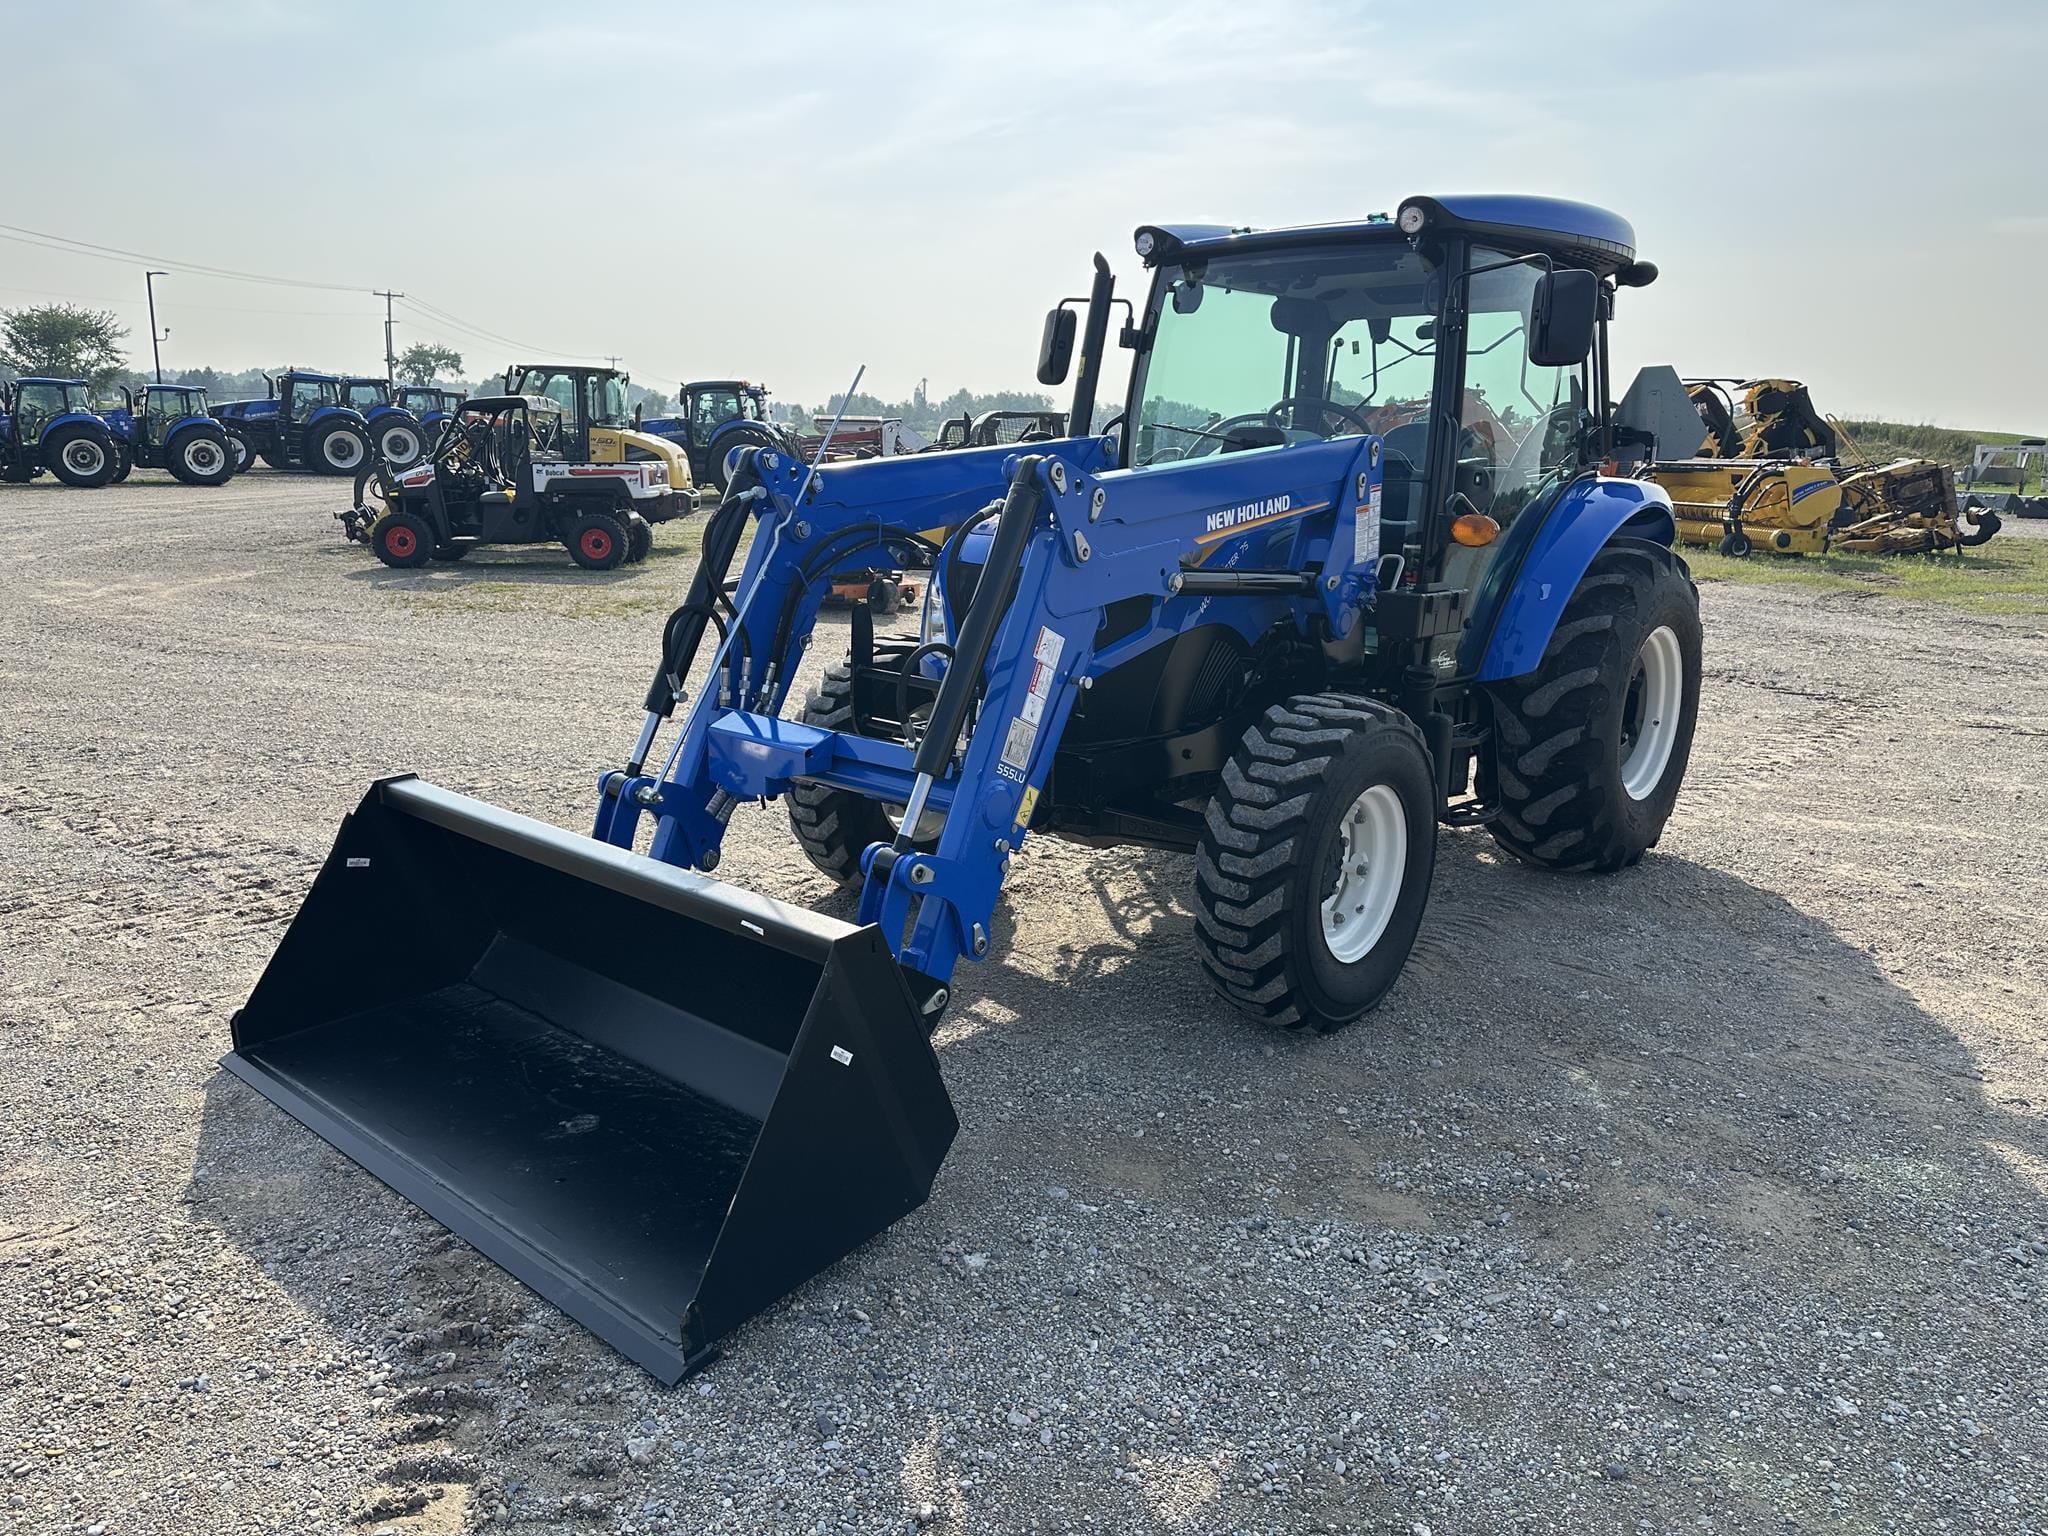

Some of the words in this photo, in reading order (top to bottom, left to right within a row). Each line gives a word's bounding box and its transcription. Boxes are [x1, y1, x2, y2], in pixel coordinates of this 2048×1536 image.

[1206, 508, 1235, 532] NEW
[1237, 494, 1291, 524] HOLLAND
[1239, 540, 1249, 555] 75
[996, 763, 1026, 784] 555LU
